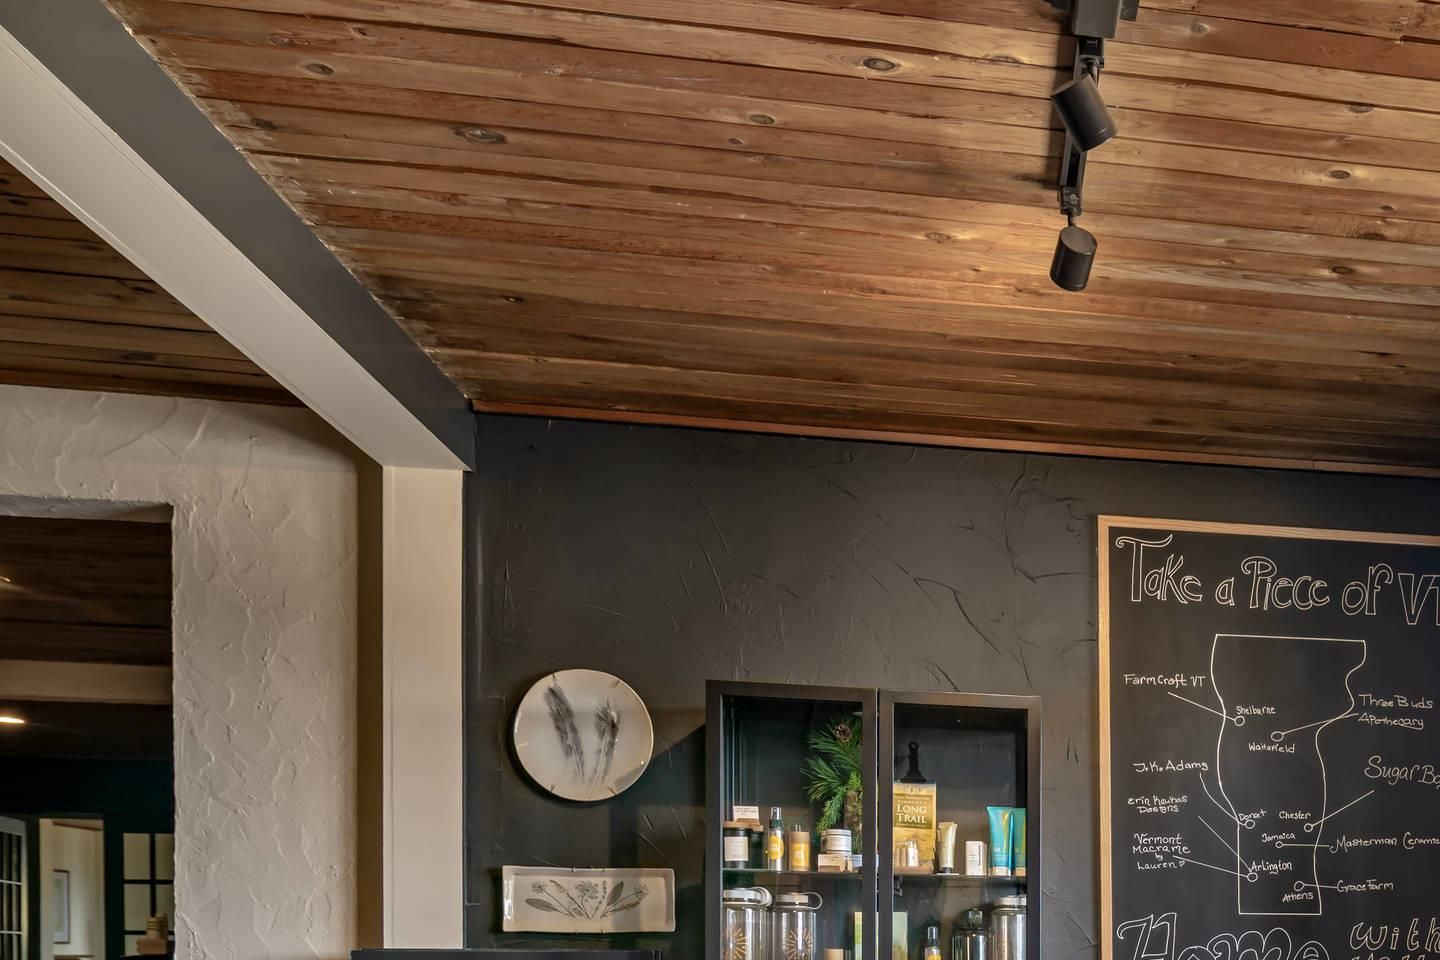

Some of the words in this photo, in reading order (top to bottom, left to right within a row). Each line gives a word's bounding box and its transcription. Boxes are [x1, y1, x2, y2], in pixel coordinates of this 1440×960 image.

[1116, 534, 1203, 604] Take
[1215, 577, 1235, 606] a
[1241, 556, 1330, 610] Piece
[1341, 563, 1393, 616] of
[1190, 675, 1206, 687] VT
[1358, 693, 1394, 707] Three
[1394, 694, 1433, 709] Buds
[1236, 705, 1276, 716] Shelburne
[1358, 712, 1424, 730] Apothecary
[1165, 760, 1209, 772] Adams
[1364, 755, 1420, 785] Sugar
[896, 803, 928, 814] LONG
[1238, 808, 1267, 821] Dorset
[896, 813, 928, 824] TRAIL
[1278, 810, 1312, 820] Chester
[1133, 833, 1183, 845] Vermont
[1261, 833, 1296, 843] Jamaica
[1329, 834, 1398, 854] Masterman
[1132, 844, 1191, 854] Macrame
[1154, 852, 1164, 861] by
[1136, 861, 1178, 870] Lauren
[1281, 891, 1314, 903] Athens
